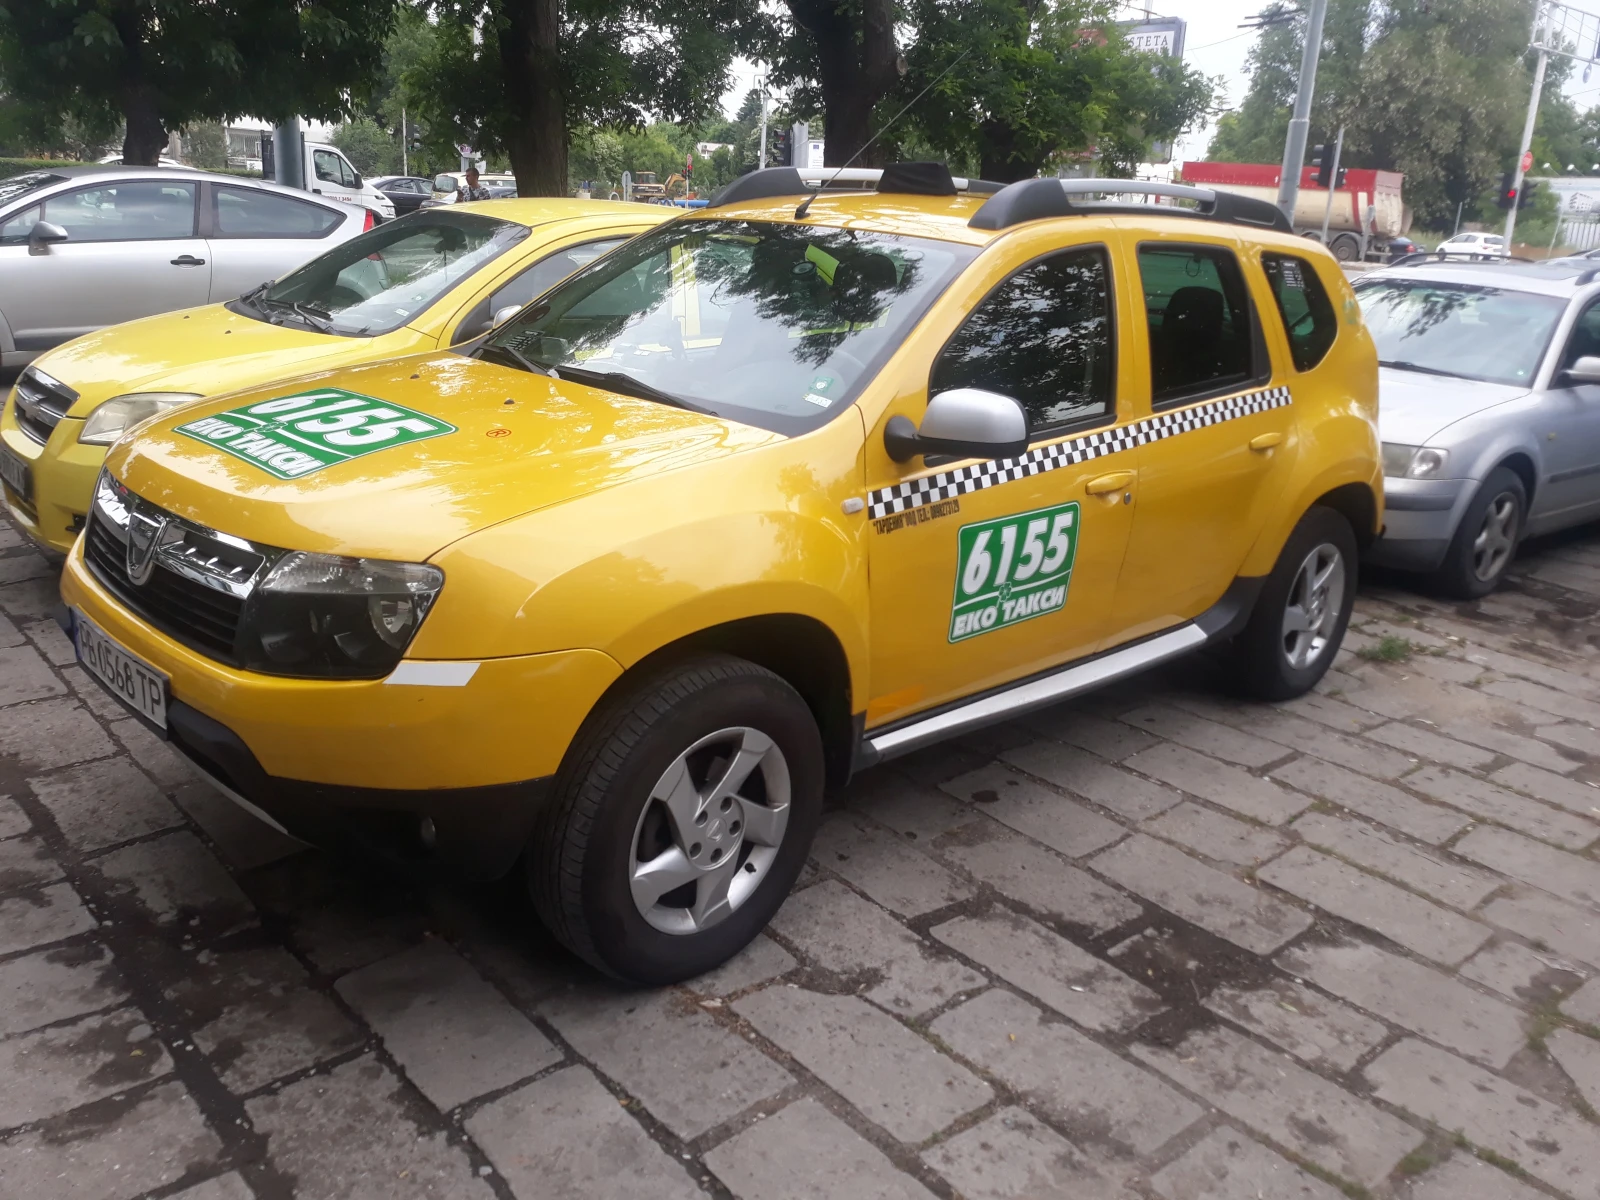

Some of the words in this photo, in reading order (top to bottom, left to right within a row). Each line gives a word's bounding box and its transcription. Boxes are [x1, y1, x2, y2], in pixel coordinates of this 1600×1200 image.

[247, 393, 439, 446] 6155
[225, 432, 326, 477] ТАКСИ
[962, 511, 1074, 595] 6155
[951, 606, 997, 638] ЕКО
[1002, 584, 1066, 622] ТАКСИ
[98, 641, 135, 700] 0568
[136, 670, 161, 716] TP
